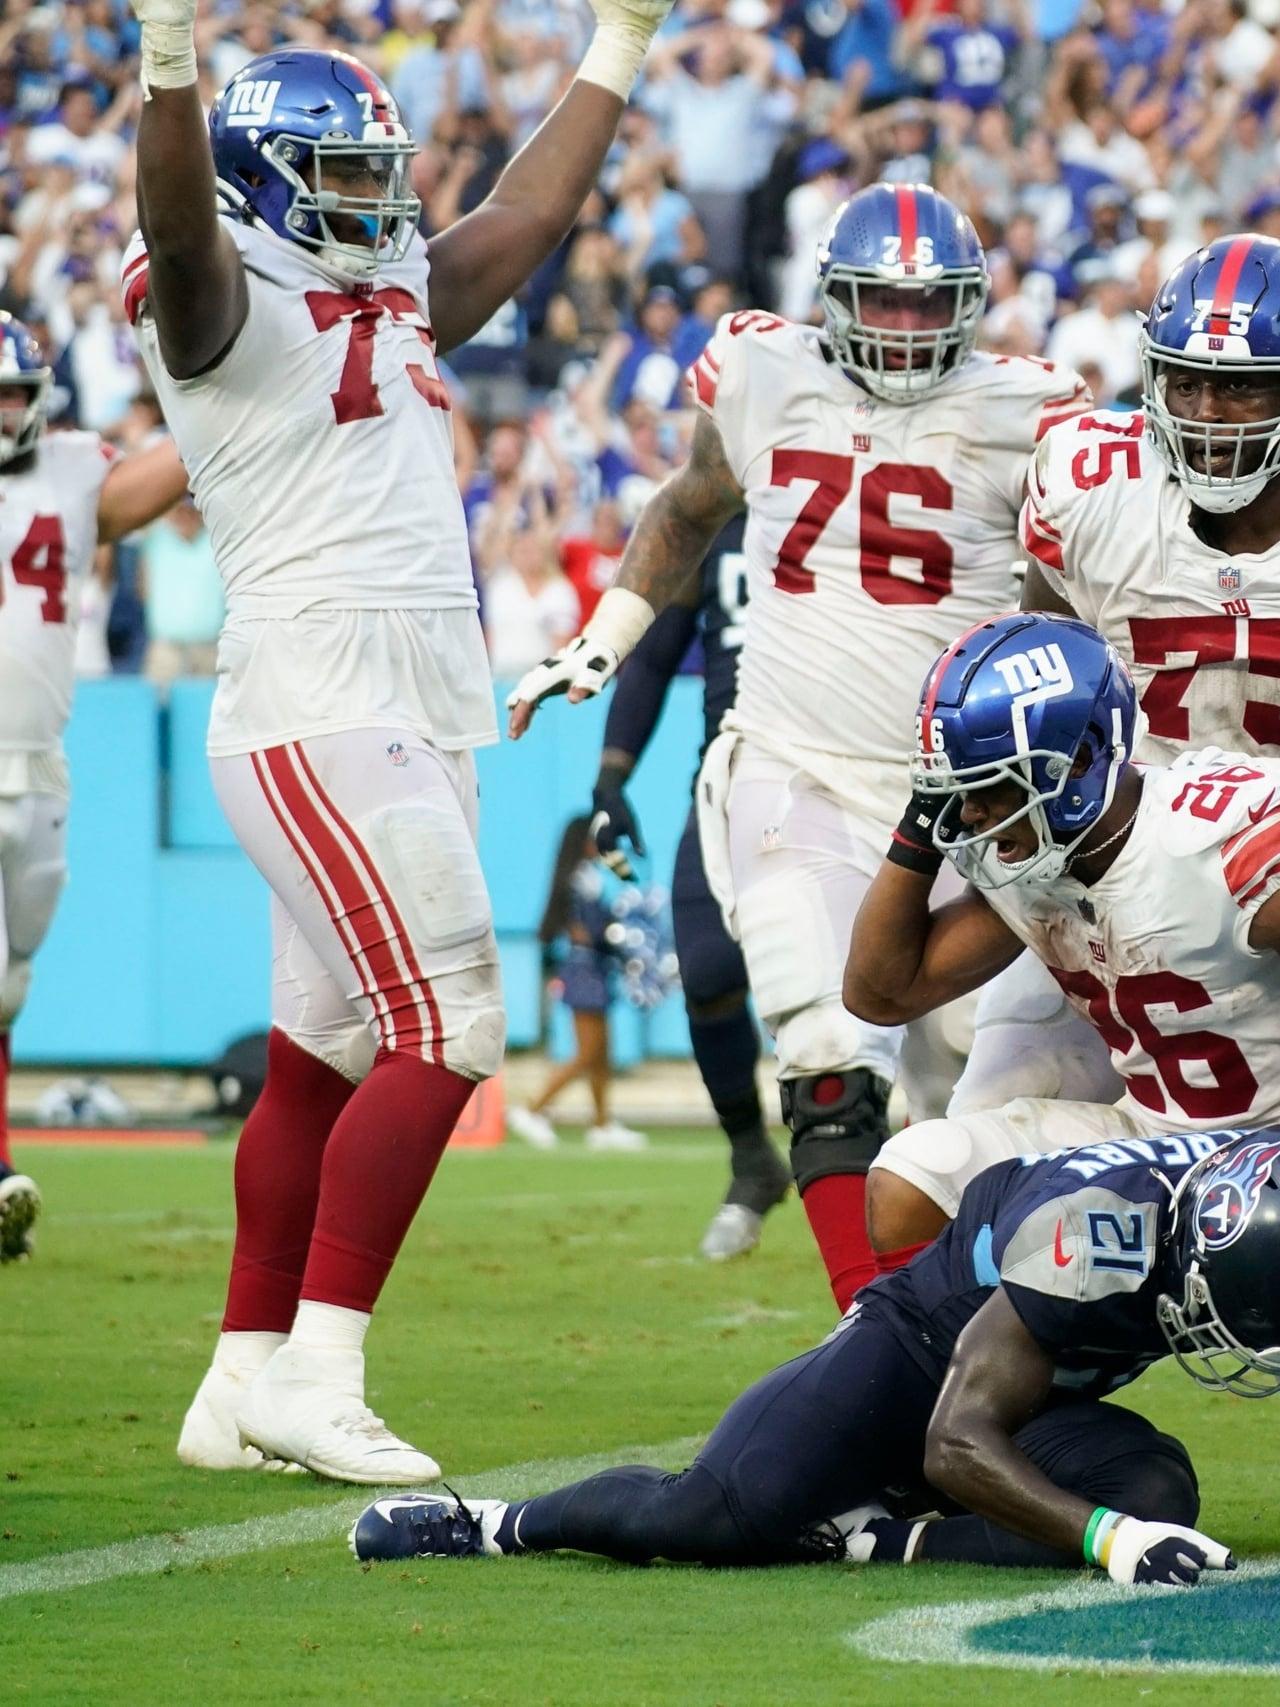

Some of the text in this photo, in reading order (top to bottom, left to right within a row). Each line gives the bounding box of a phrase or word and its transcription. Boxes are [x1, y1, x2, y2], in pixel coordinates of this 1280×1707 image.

[882, 235, 934, 264] 76
[1191, 299, 1254, 336] 75
[1071, 414, 1146, 491] 75
[0, 508, 67, 623] 4
[770, 448, 954, 606] 76
[1046, 964, 1260, 1119] 26
[1086, 1209, 1147, 1277] 12
